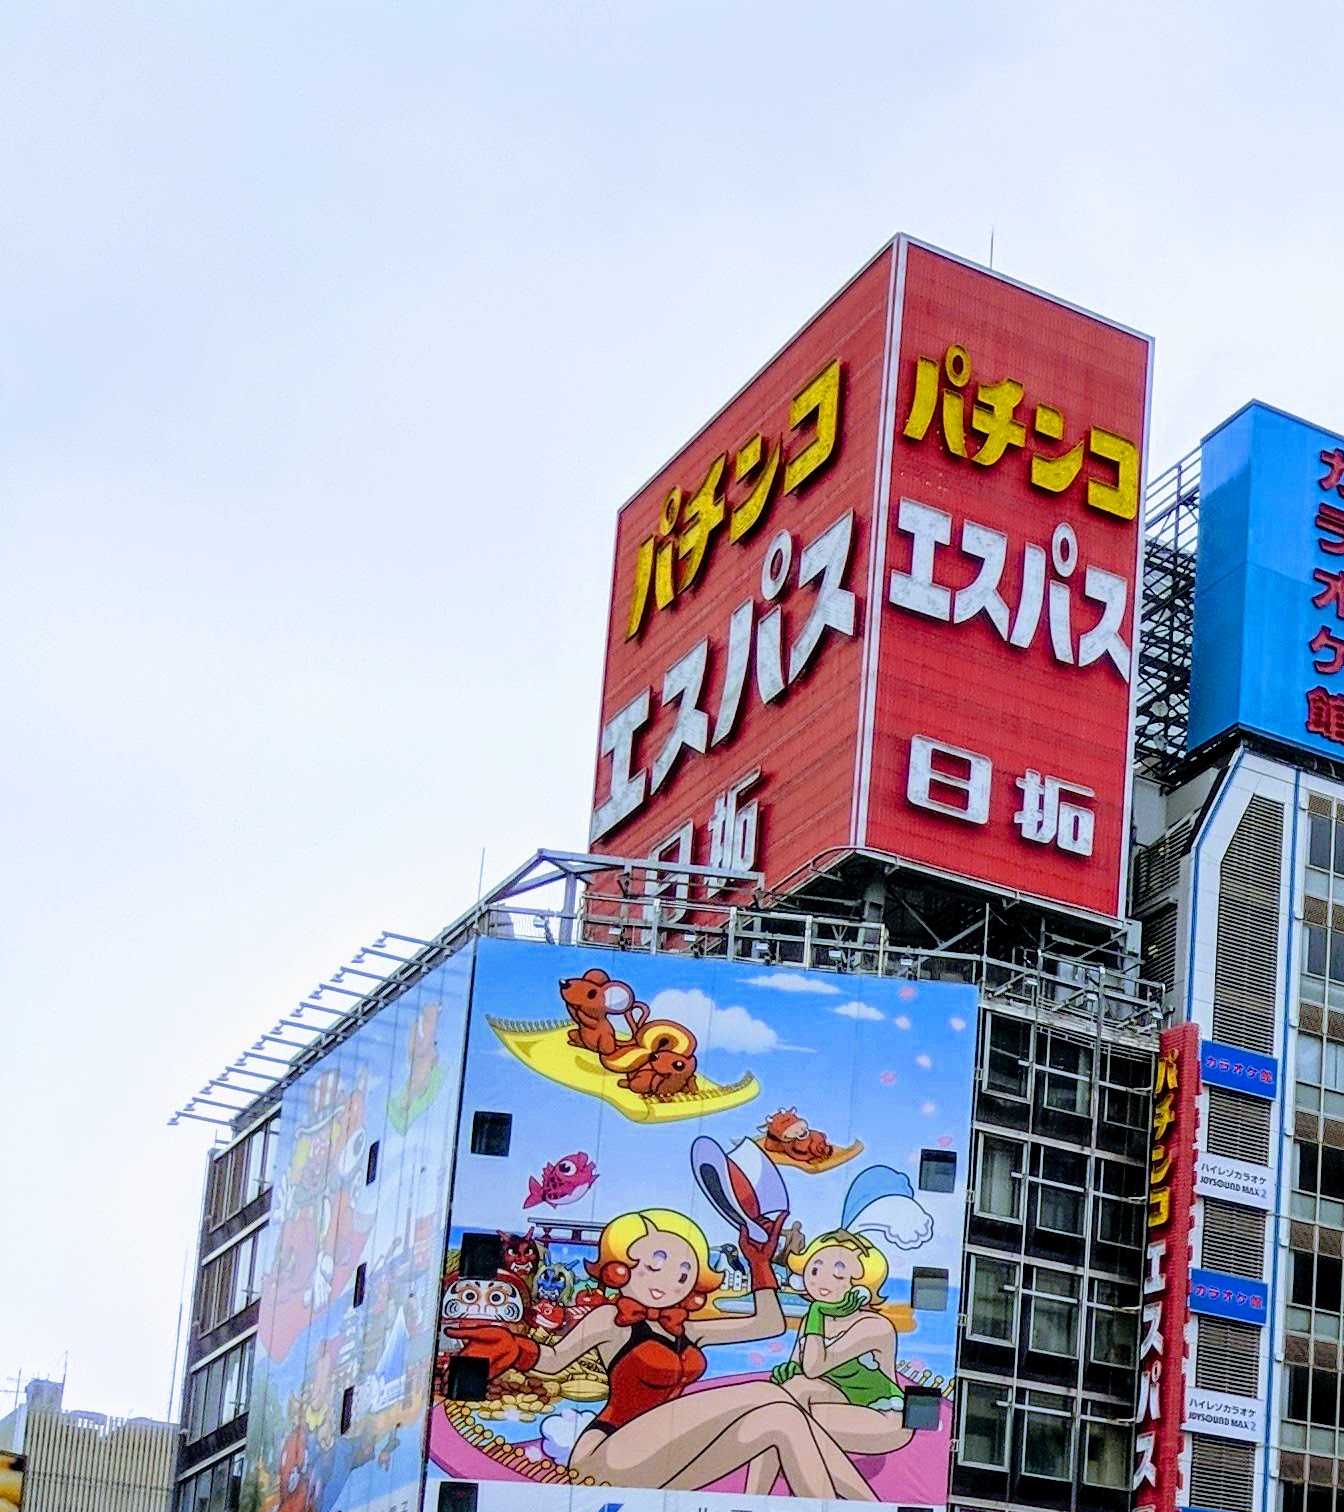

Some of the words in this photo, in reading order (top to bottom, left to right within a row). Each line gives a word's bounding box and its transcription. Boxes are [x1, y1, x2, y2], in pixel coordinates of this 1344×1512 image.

[627, 357, 843, 642] パチンコ
[905, 344, 1140, 520] パチンコ
[592, 510, 857, 842] エスパス
[889, 498, 1130, 684] エスパス
[907, 733, 1096, 857] 日拓
[1148, 1049, 1179, 1228] パチンコ
[1133, 1241, 1166, 1489] エスパス
